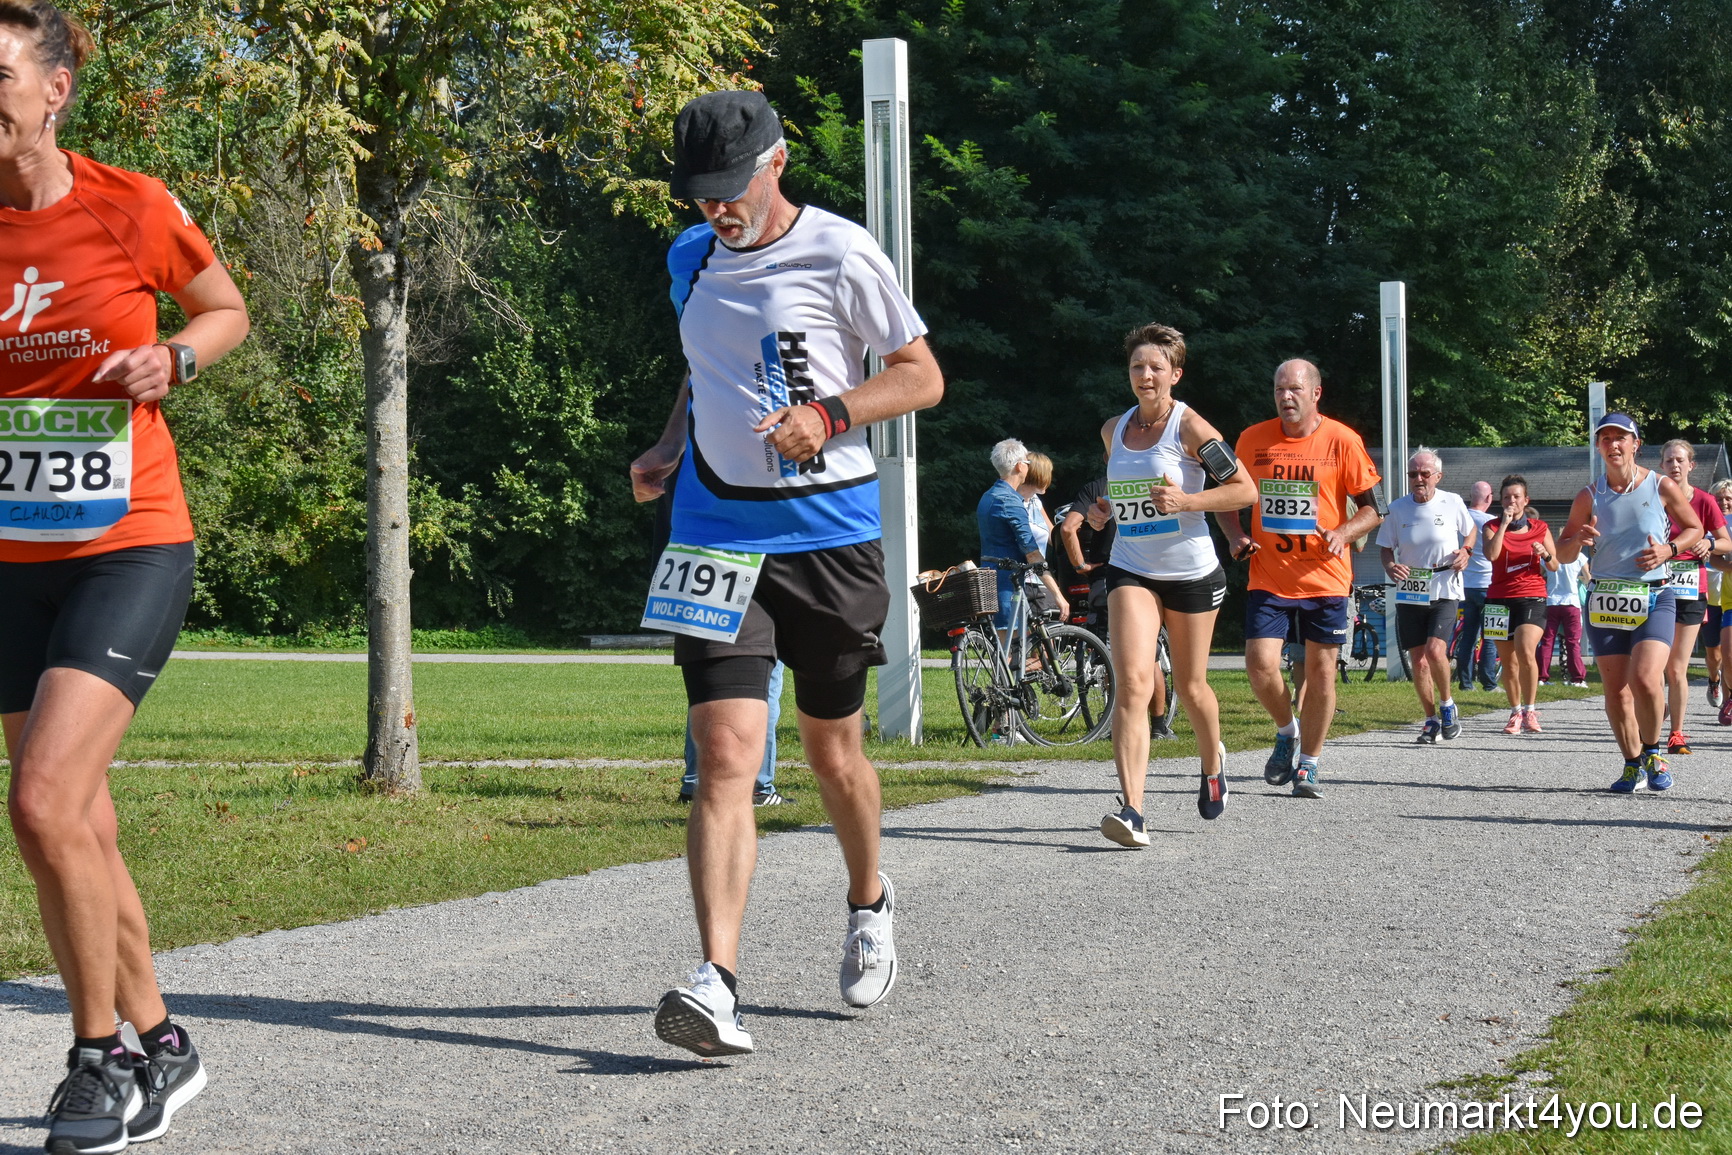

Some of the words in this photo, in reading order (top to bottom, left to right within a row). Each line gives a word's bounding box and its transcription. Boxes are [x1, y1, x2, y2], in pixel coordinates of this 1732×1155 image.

[9, 338, 111, 364] neumarkt
[754, 362, 767, 394] WASTE
[0, 451, 112, 492] 2738
[1273, 464, 1315, 480] RUN
[1263, 480, 1313, 495] BOCK
[1115, 499, 1169, 521] 276
[1265, 498, 1311, 516] 2832
[1130, 524, 1158, 535] ALEX
[658, 558, 738, 603] 2191
[1400, 579, 1426, 593] 2082
[1597, 581, 1643, 594] BOCK
[1596, 595, 1642, 613] 1020
[652, 601, 731, 627] WOLFGANG
[1599, 615, 1637, 625] DANIELA
